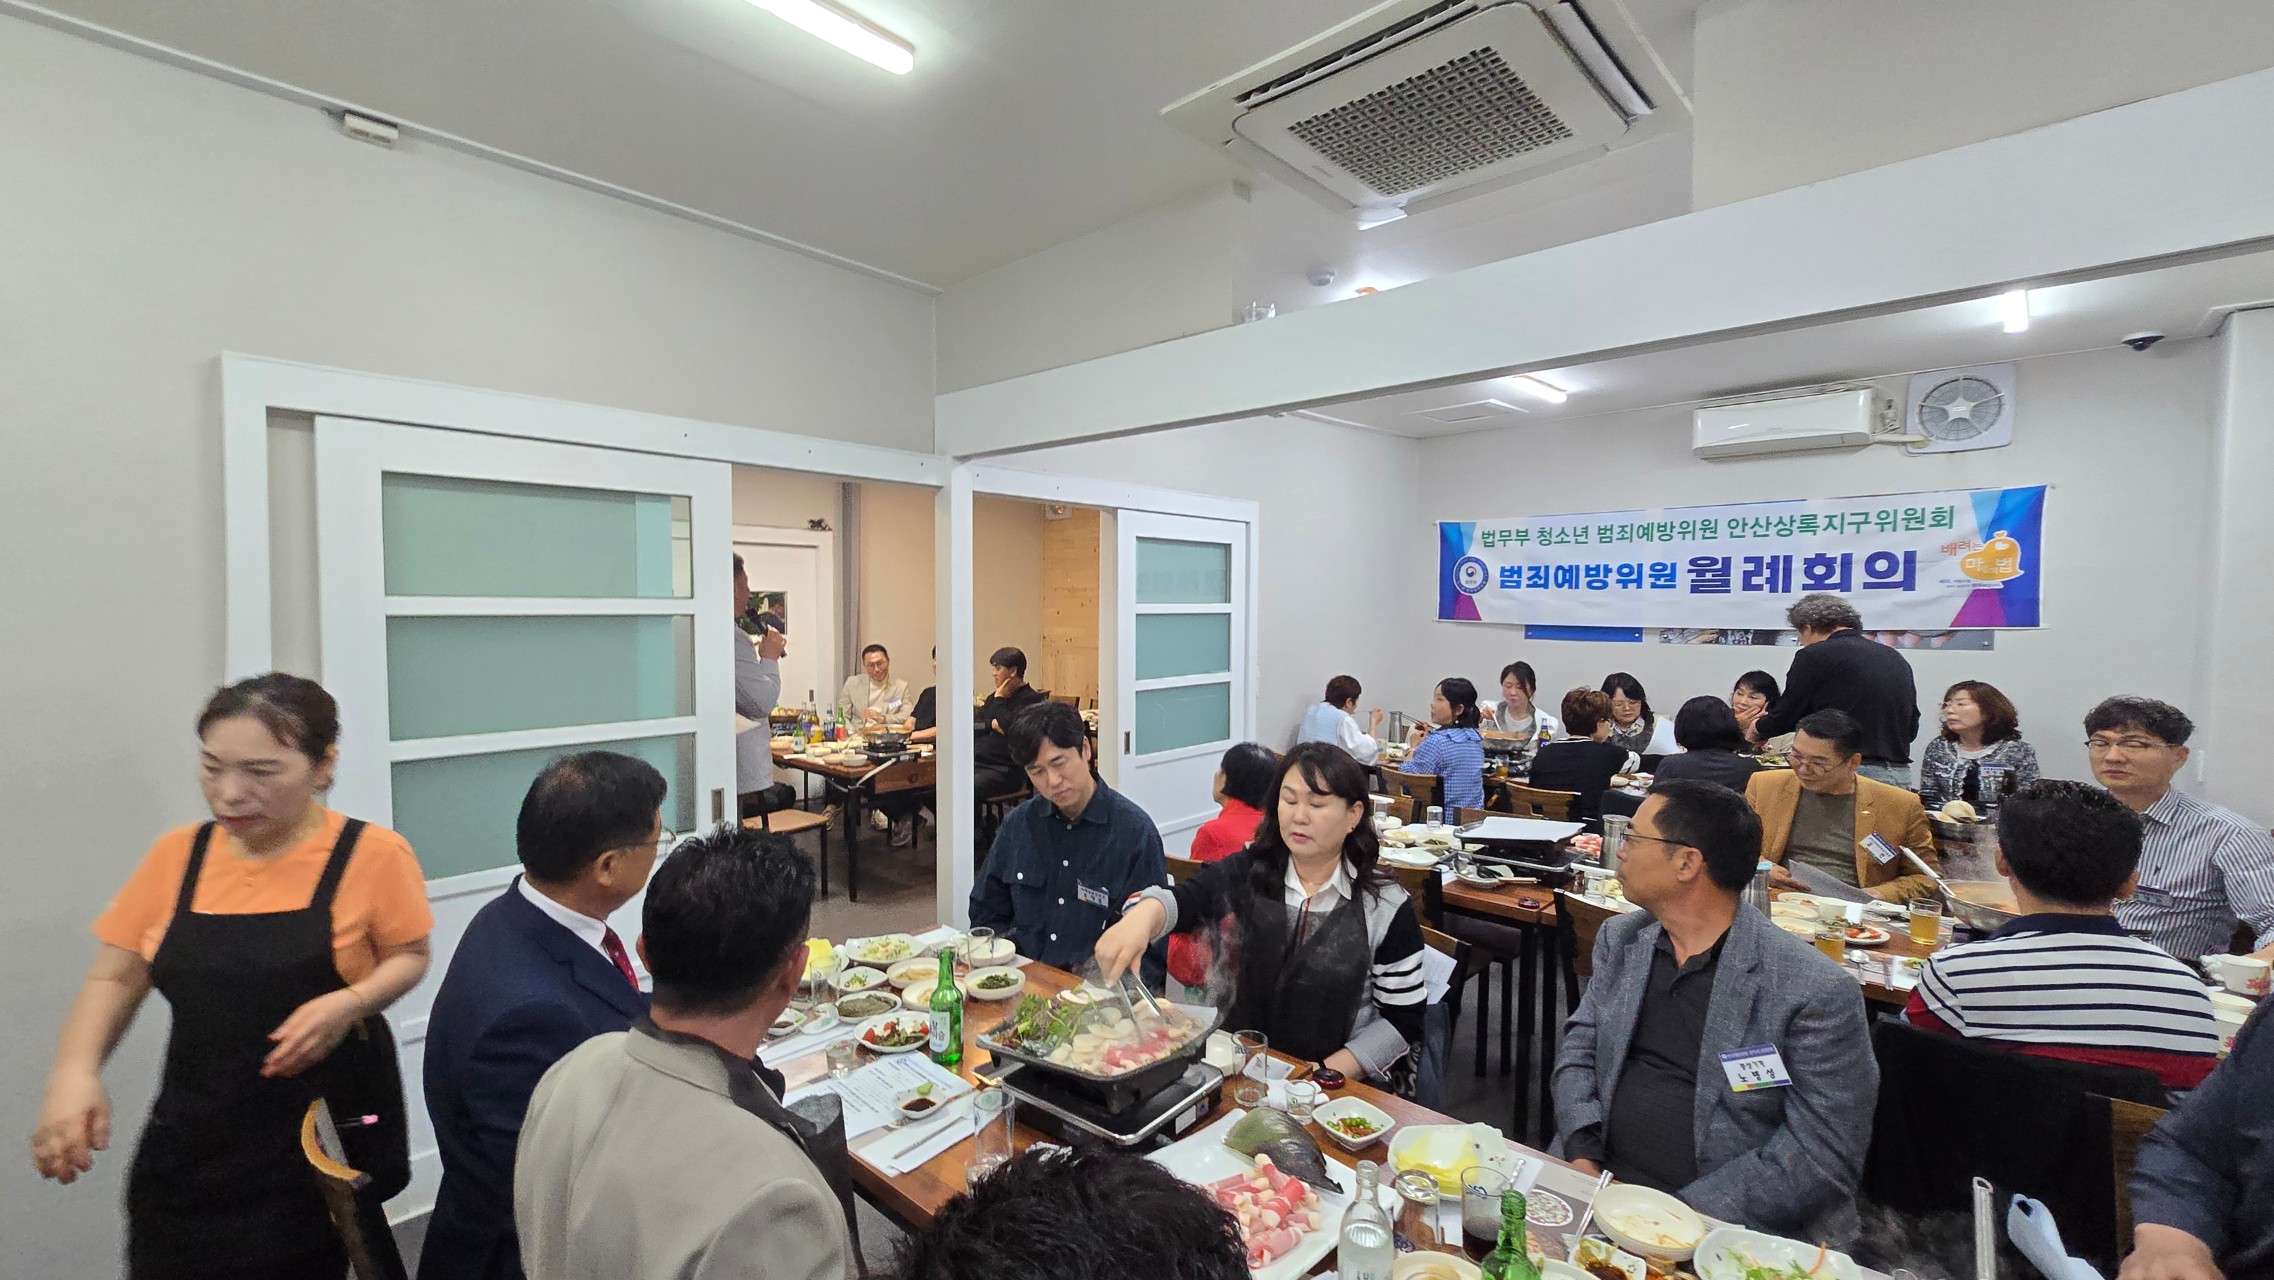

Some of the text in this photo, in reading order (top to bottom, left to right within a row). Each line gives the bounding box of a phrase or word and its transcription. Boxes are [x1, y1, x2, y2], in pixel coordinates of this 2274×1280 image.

[1481, 505, 1955, 548] 법무부 청소년 범죄예방위원 안산상록지구위원회
[1499, 562, 1677, 590] 범죄예방위원
[1687, 550, 1918, 594] 월례회의
